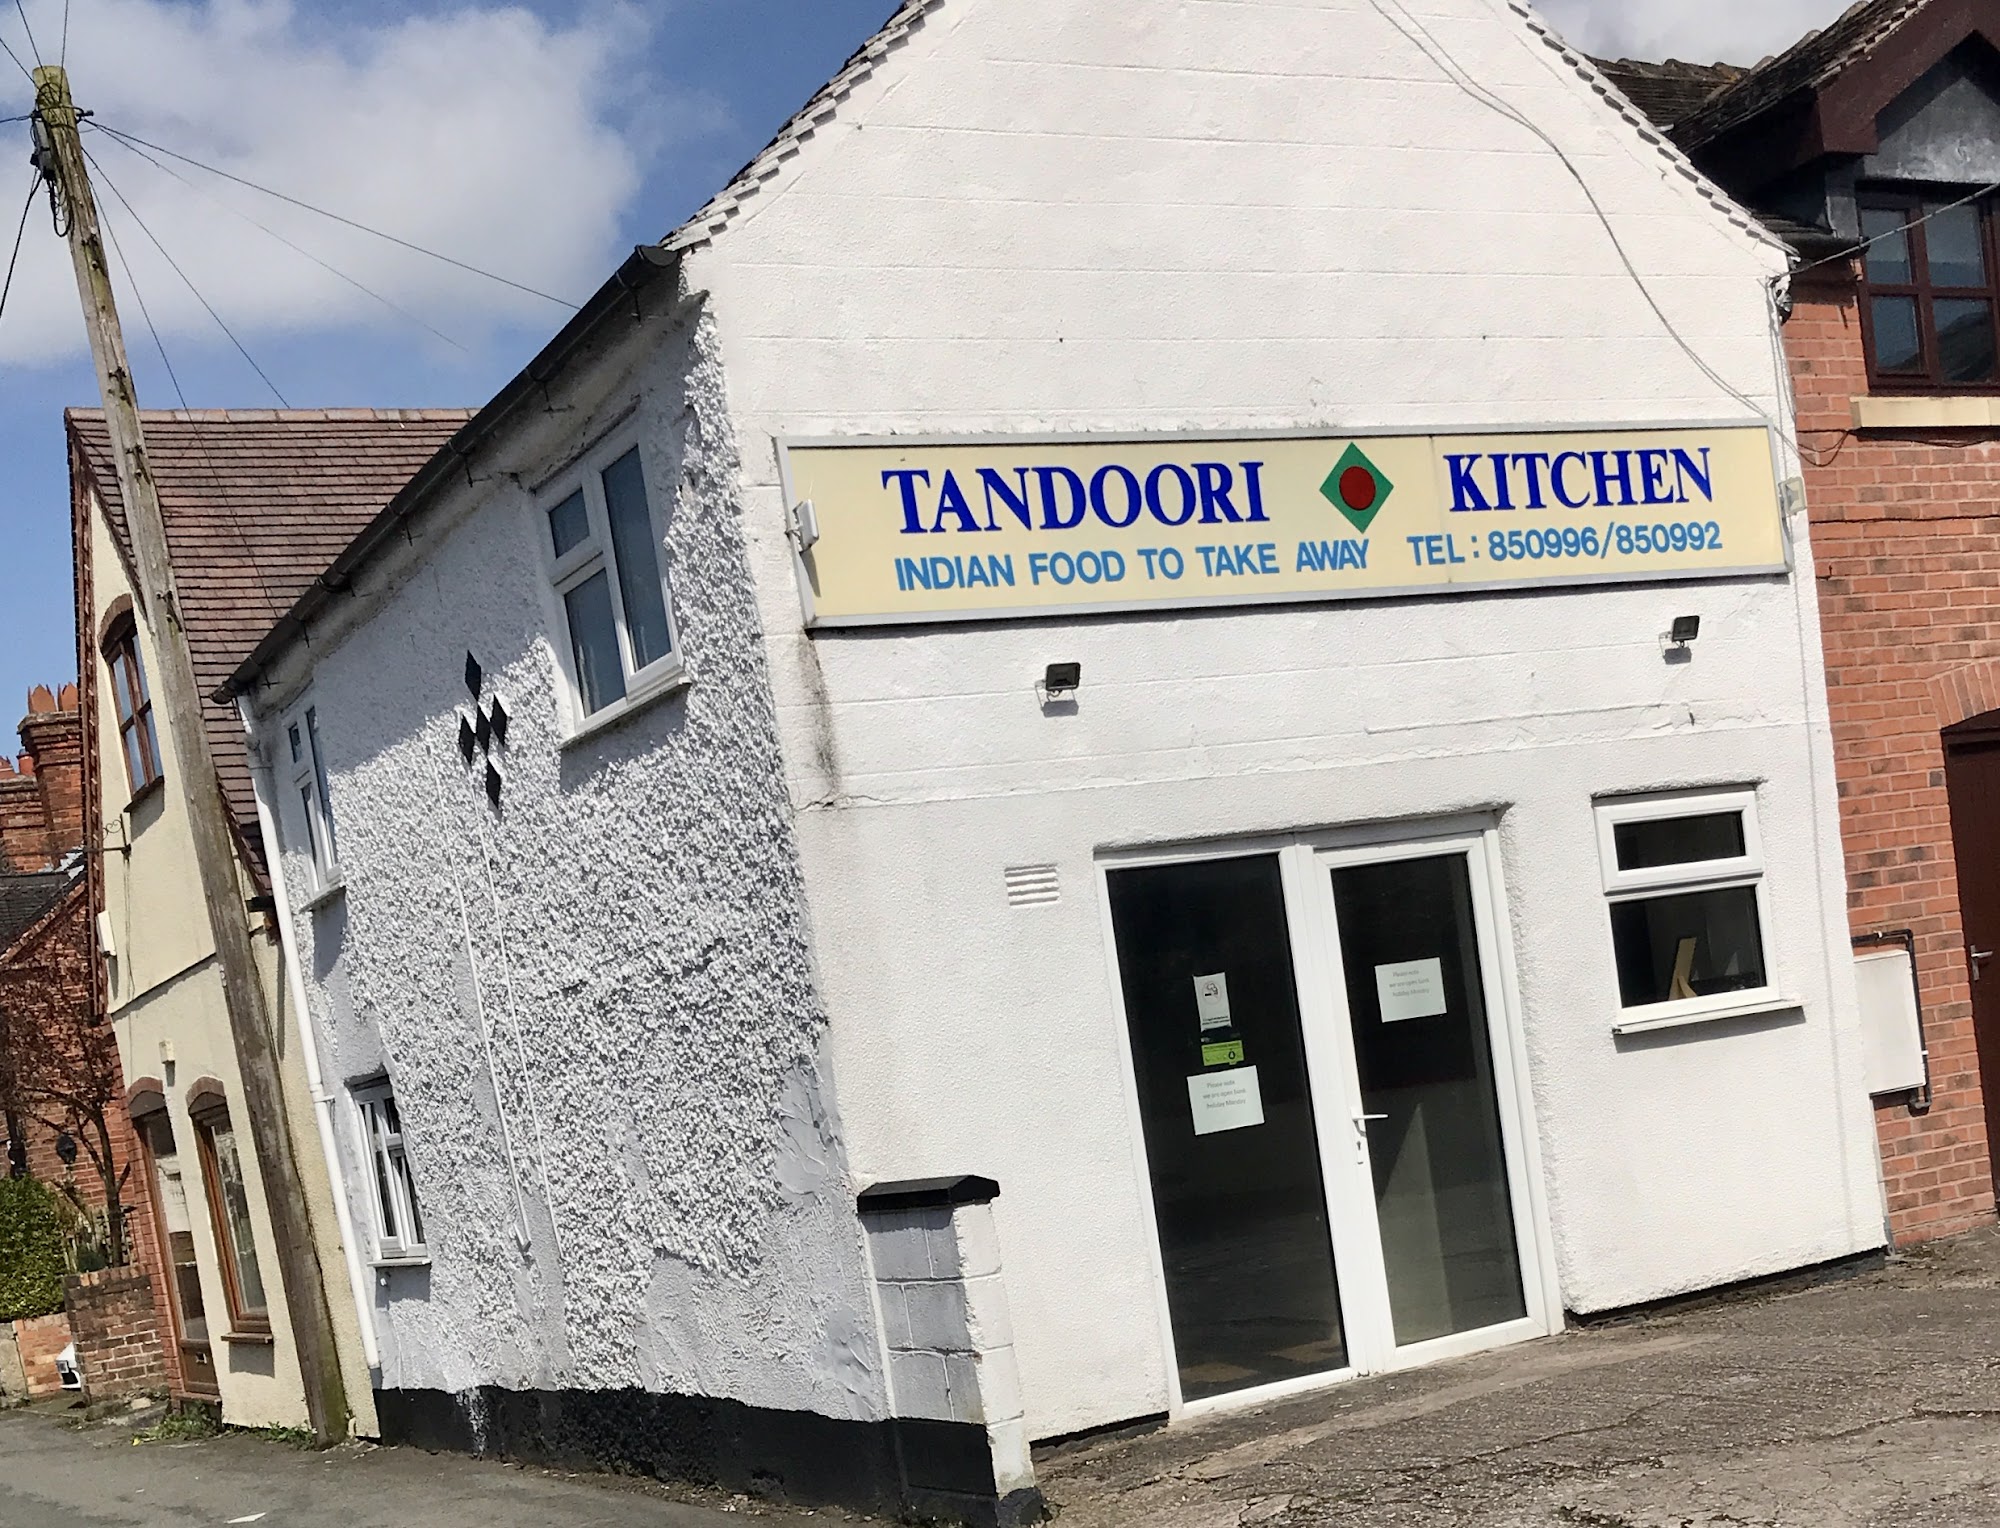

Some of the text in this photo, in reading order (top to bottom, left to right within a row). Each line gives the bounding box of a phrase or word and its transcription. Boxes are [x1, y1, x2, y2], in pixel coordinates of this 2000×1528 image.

[882, 447, 1714, 534] TANDOORI KITCHEN
[895, 554, 1015, 591] INDIAN
[1028, 550, 1126, 585] FOOD
[1137, 547, 1184, 581] TO
[1196, 543, 1280, 577] TAKE
[1296, 538, 1370, 572] AWAY
[1488, 521, 1723, 561] 850996/850992
